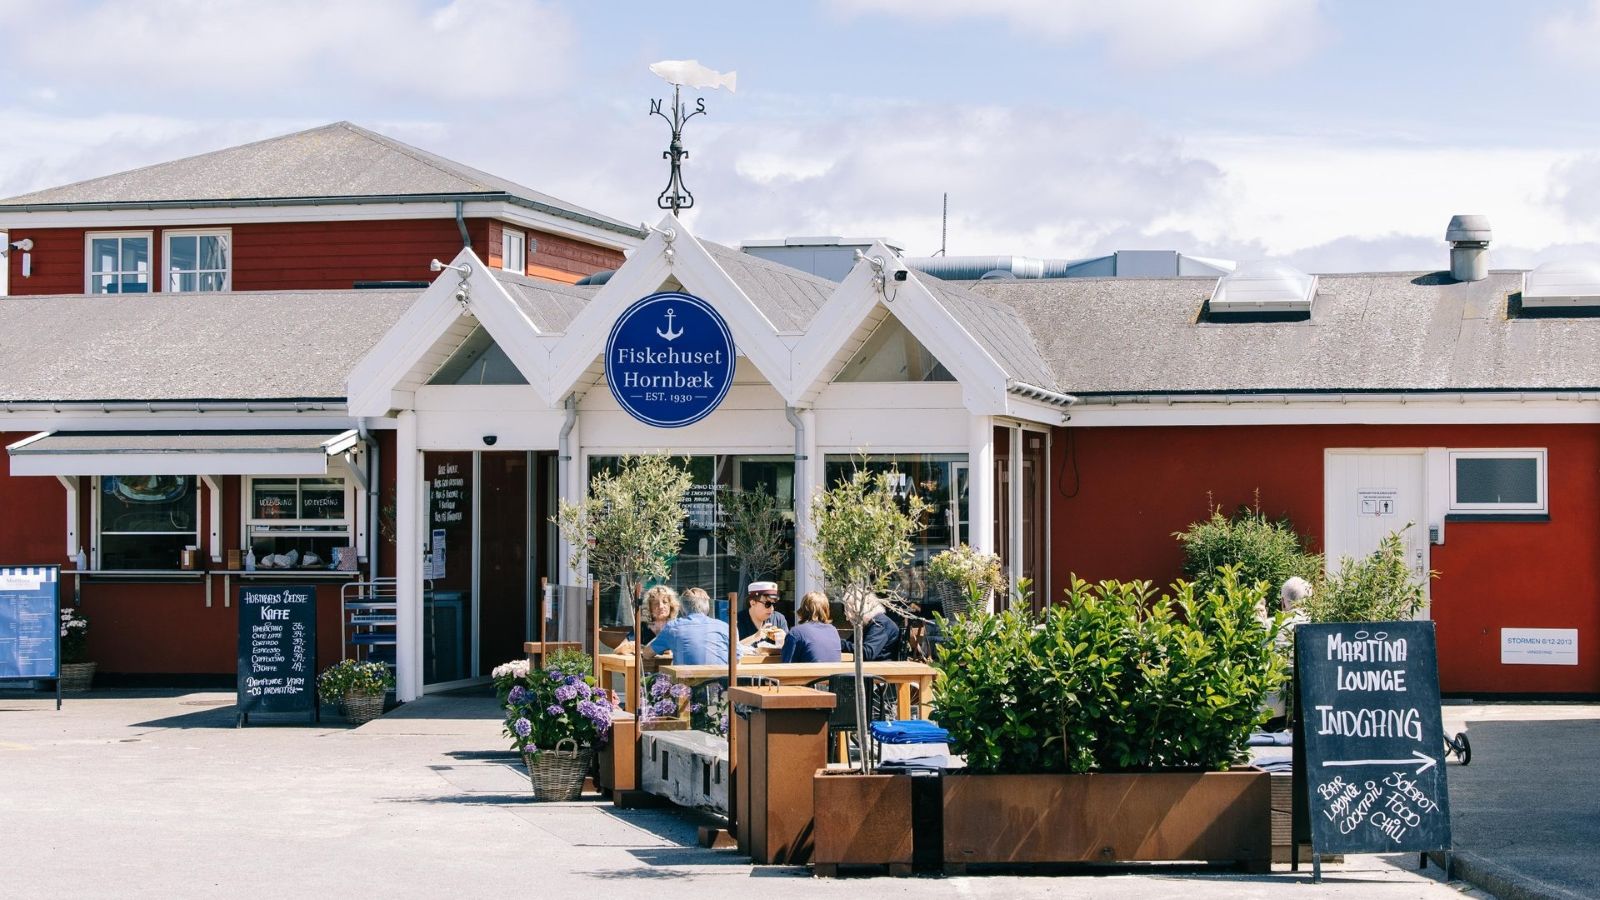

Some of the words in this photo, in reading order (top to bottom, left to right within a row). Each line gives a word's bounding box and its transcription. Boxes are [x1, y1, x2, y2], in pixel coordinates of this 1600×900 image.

[650, 98, 662, 113] N
[696, 97, 705, 112] S
[618, 347, 722, 364] Fiskehuset
[623, 371, 714, 388] Hornbæk
[645, 392, 667, 401] EST.
[670, 394, 693, 403] 1930
[261, 605, 290, 620] KAFFE
[1327, 632, 1407, 662] MARITINA
[1337, 665, 1407, 692] LOUNGE
[1315, 705, 1423, 742] INDGANG
[1317, 775, 1346, 800] BAR
[1323, 782, 1361, 823] LOUNGE
[1339, 780, 1383, 835] COCKTAIL
[1384, 790, 1421, 827] FOOD
